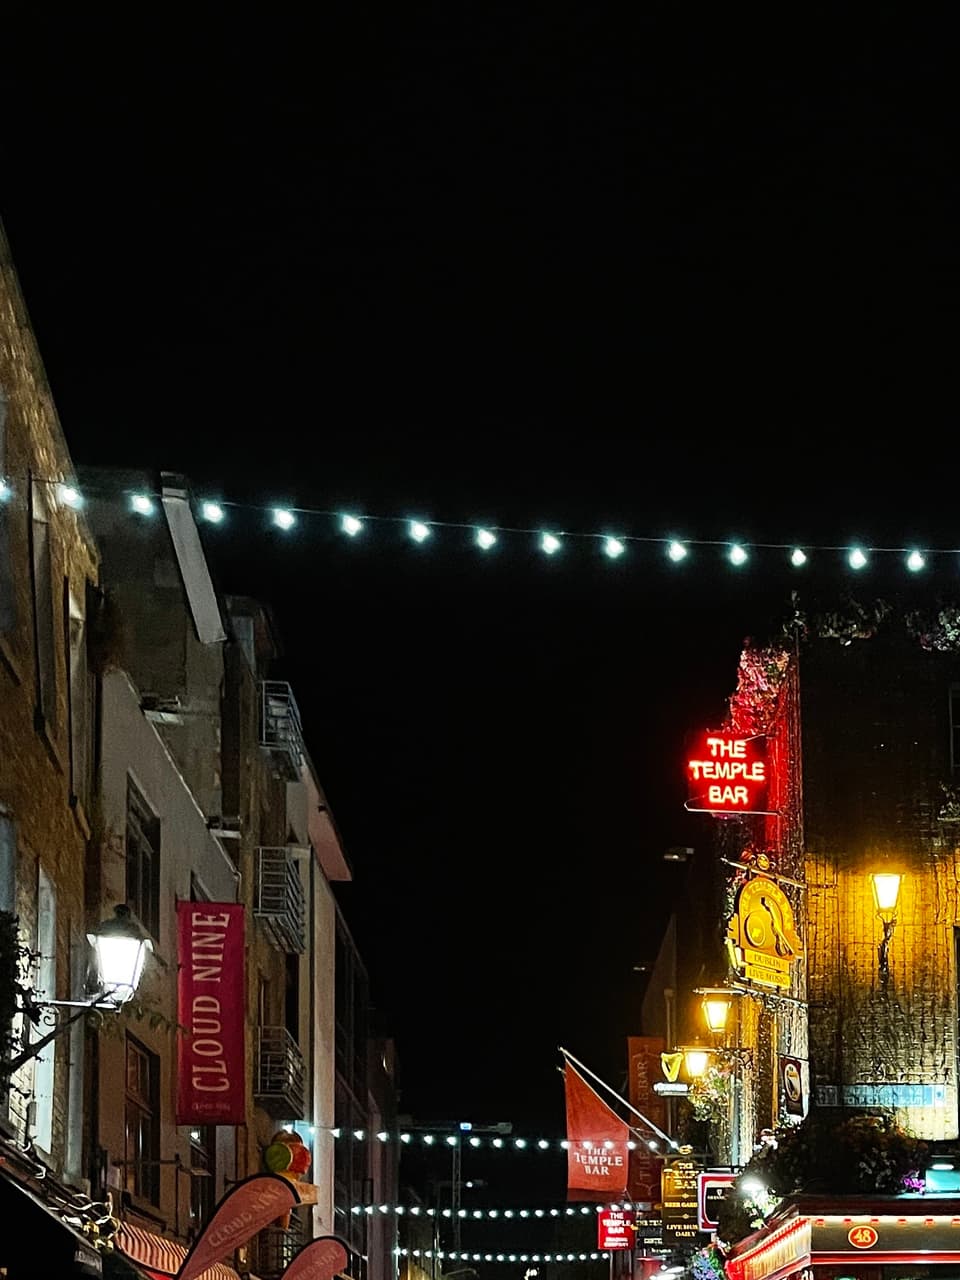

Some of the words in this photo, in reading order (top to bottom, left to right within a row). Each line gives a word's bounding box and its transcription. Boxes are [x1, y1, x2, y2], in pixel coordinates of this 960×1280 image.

[707, 738, 747, 758] THE
[688, 760, 765, 781] TEMPLE
[708, 785, 748, 804] BAR
[192, 912, 230, 983] NINE
[192, 995, 230, 1092] CLOUD
[574, 1152, 623, 1166] TEMPLE
[584, 1166, 610, 1176] BAR
[853, 1229, 872, 1243] 48
